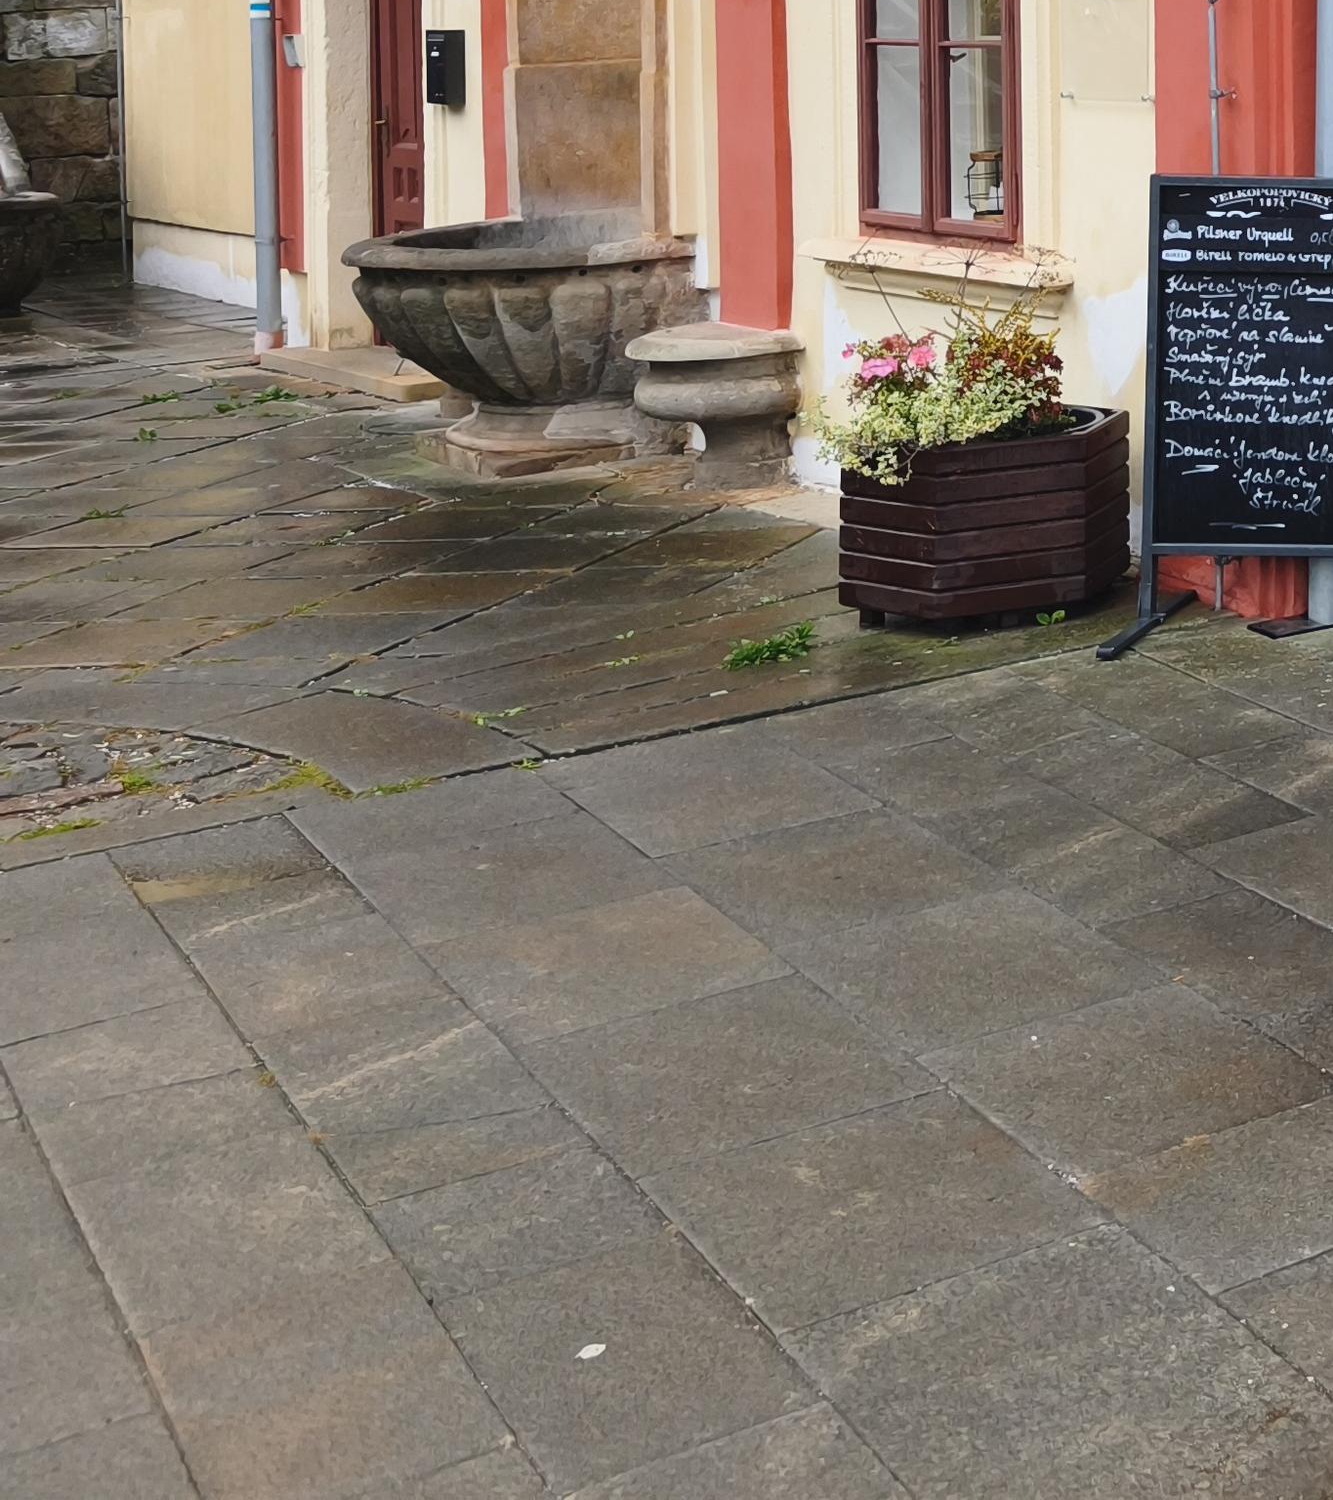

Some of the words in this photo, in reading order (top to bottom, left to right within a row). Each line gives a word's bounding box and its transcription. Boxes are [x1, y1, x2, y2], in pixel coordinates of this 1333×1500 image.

[1209, 188, 1333, 207] VELKOPOPOVICKÝ
[1259, 197, 1285, 207] 1874
[1196, 226, 1243, 241] Pilsner
[1246, 227, 1294, 247] Urquell
[1195, 249, 1232, 262] Birell
[1164, 274, 1236, 294] Kuřecí
[1238, 329, 1260, 343] na
